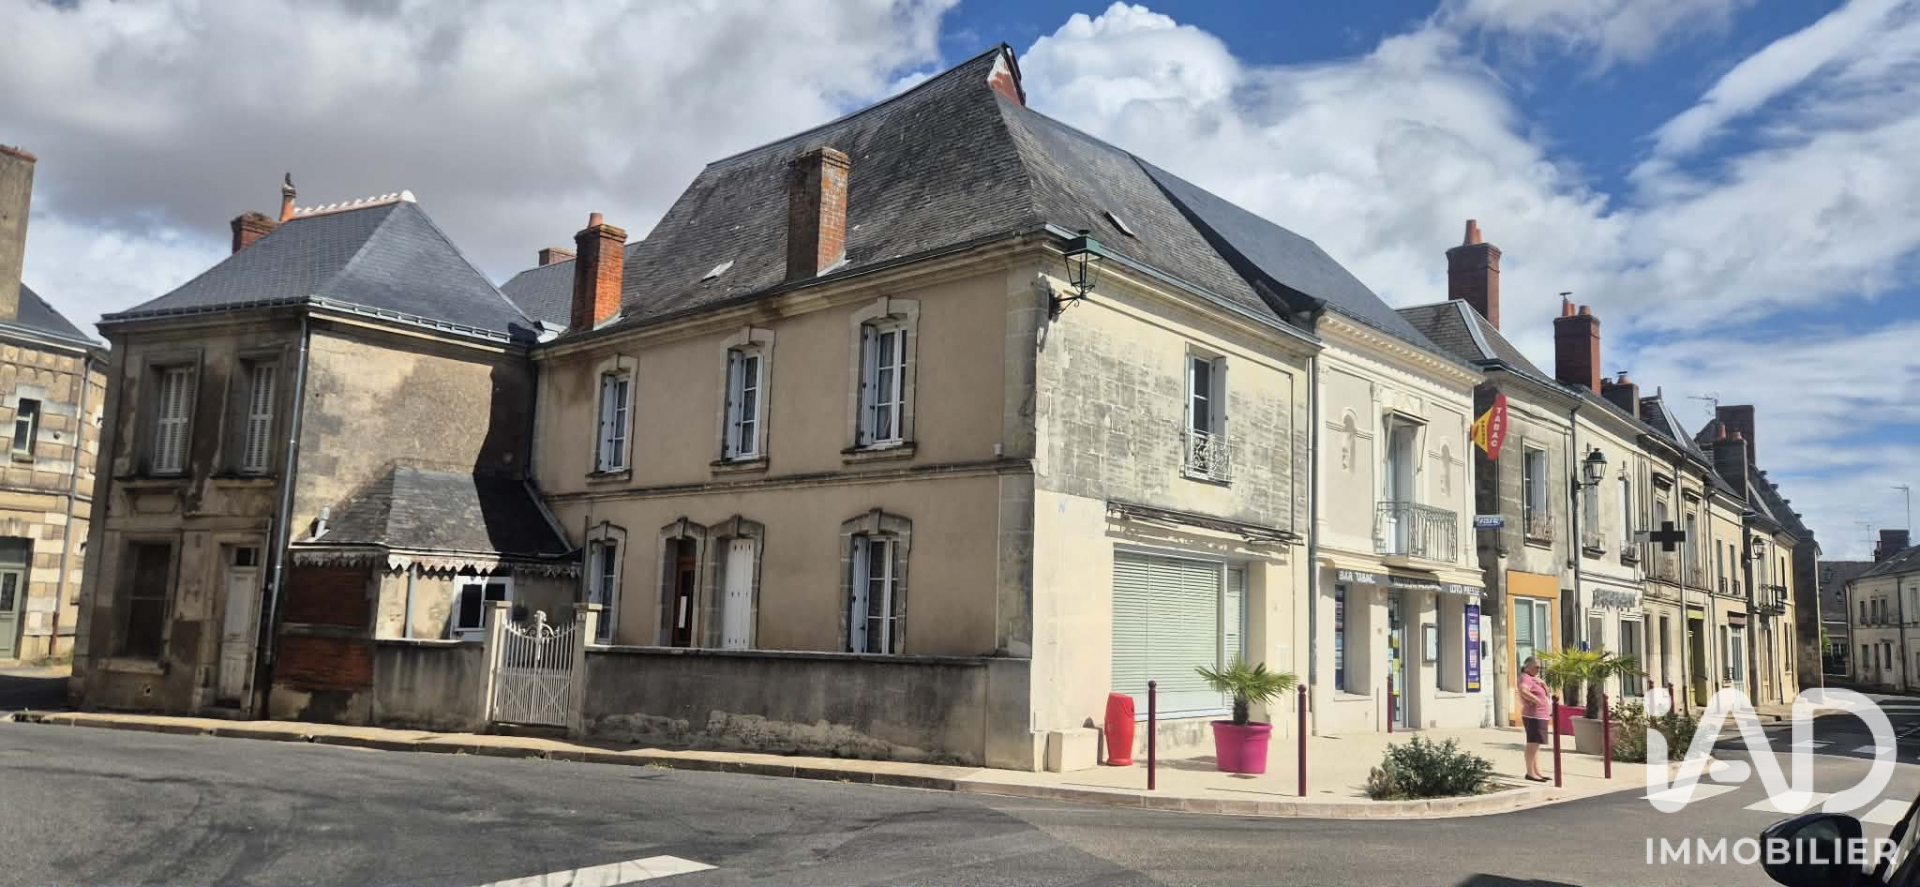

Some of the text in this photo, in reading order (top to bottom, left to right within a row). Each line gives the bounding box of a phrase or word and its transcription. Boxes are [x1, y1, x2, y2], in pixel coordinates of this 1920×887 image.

[1491, 407, 1502, 447] TABAC
[1338, 570, 1377, 585] BAR TABAC
